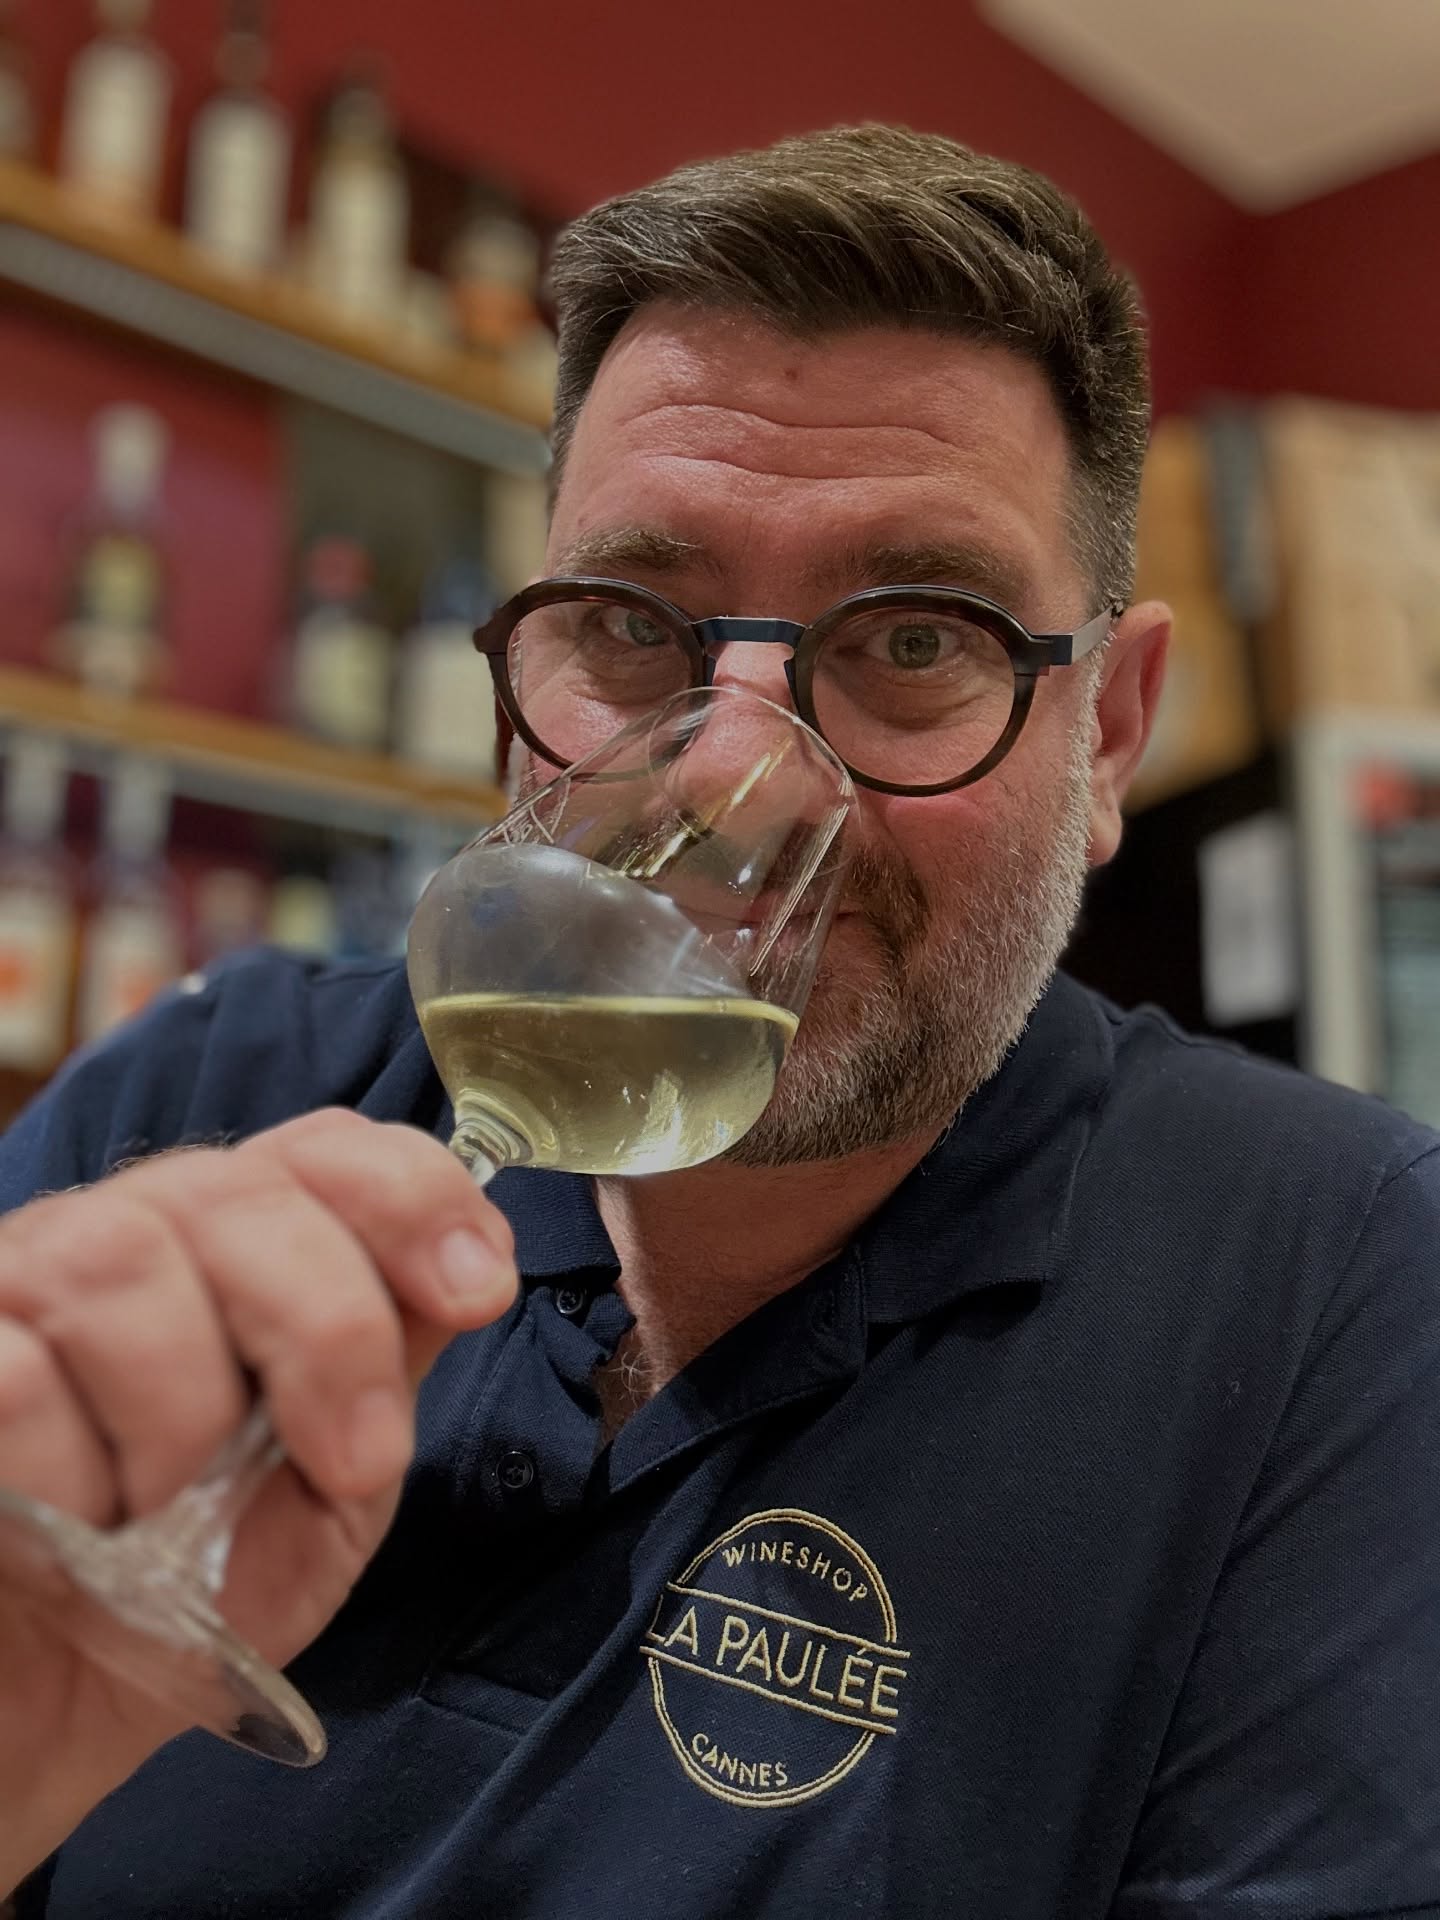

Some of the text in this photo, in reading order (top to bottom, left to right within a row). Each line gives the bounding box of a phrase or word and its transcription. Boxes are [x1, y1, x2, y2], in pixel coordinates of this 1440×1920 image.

[722, 1541, 868, 1602] WINESHOP
[715, 1615, 908, 1718] PAULÉE
[692, 1733, 789, 1788] CANNES
